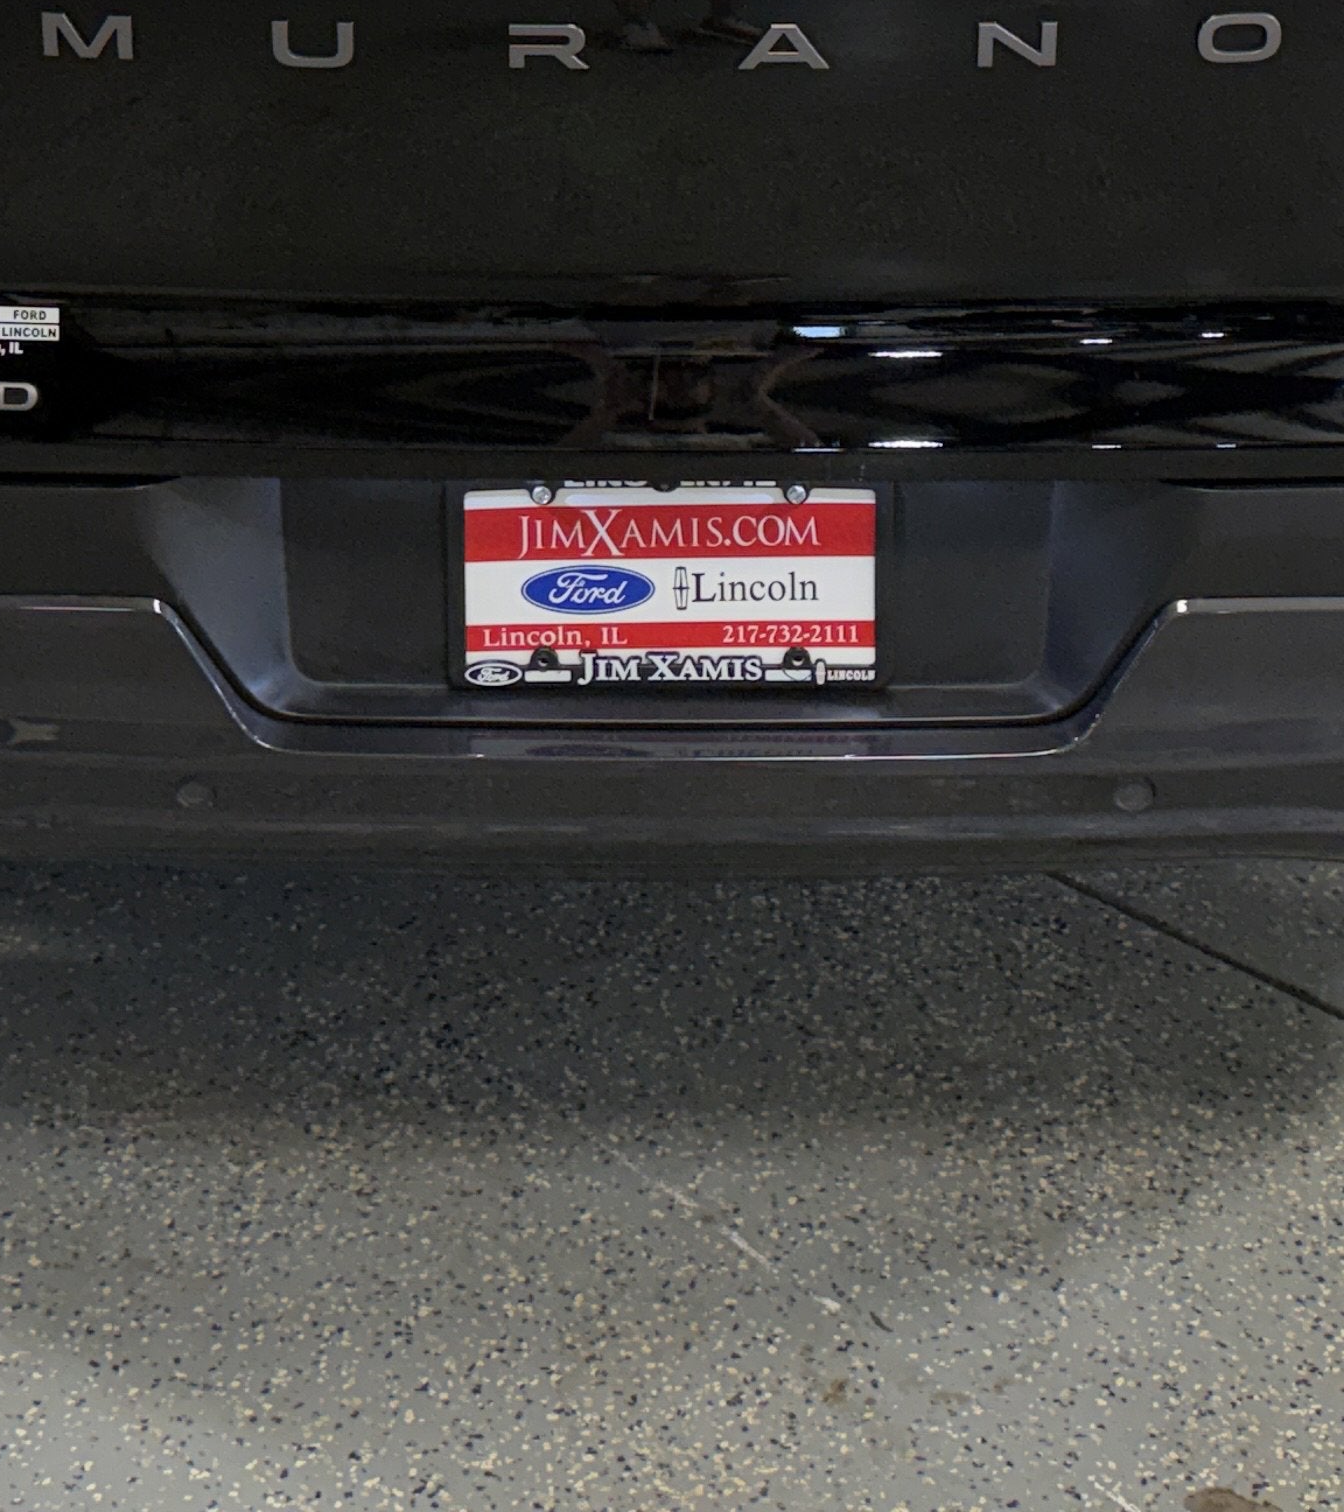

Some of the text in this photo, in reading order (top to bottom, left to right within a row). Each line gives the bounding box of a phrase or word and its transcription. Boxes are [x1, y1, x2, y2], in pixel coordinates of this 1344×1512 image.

[40, 10, 1283, 69] MURANO
[13, 309, 47, 321] FORD
[1, 327, 57, 338] LINCOLN
[8, 341, 24, 354] IL
[518, 509, 821, 559] JIMXAMIS.COM
[548, 571, 627, 606] Ford
[691, 571, 819, 603] Lincoln
[483, 628, 628, 647] Lincoln, IL
[722, 625, 859, 644] 217-732-2111
[577, 652, 763, 686] JIM XAMIS
[827, 670, 876, 681] LINCOLN
